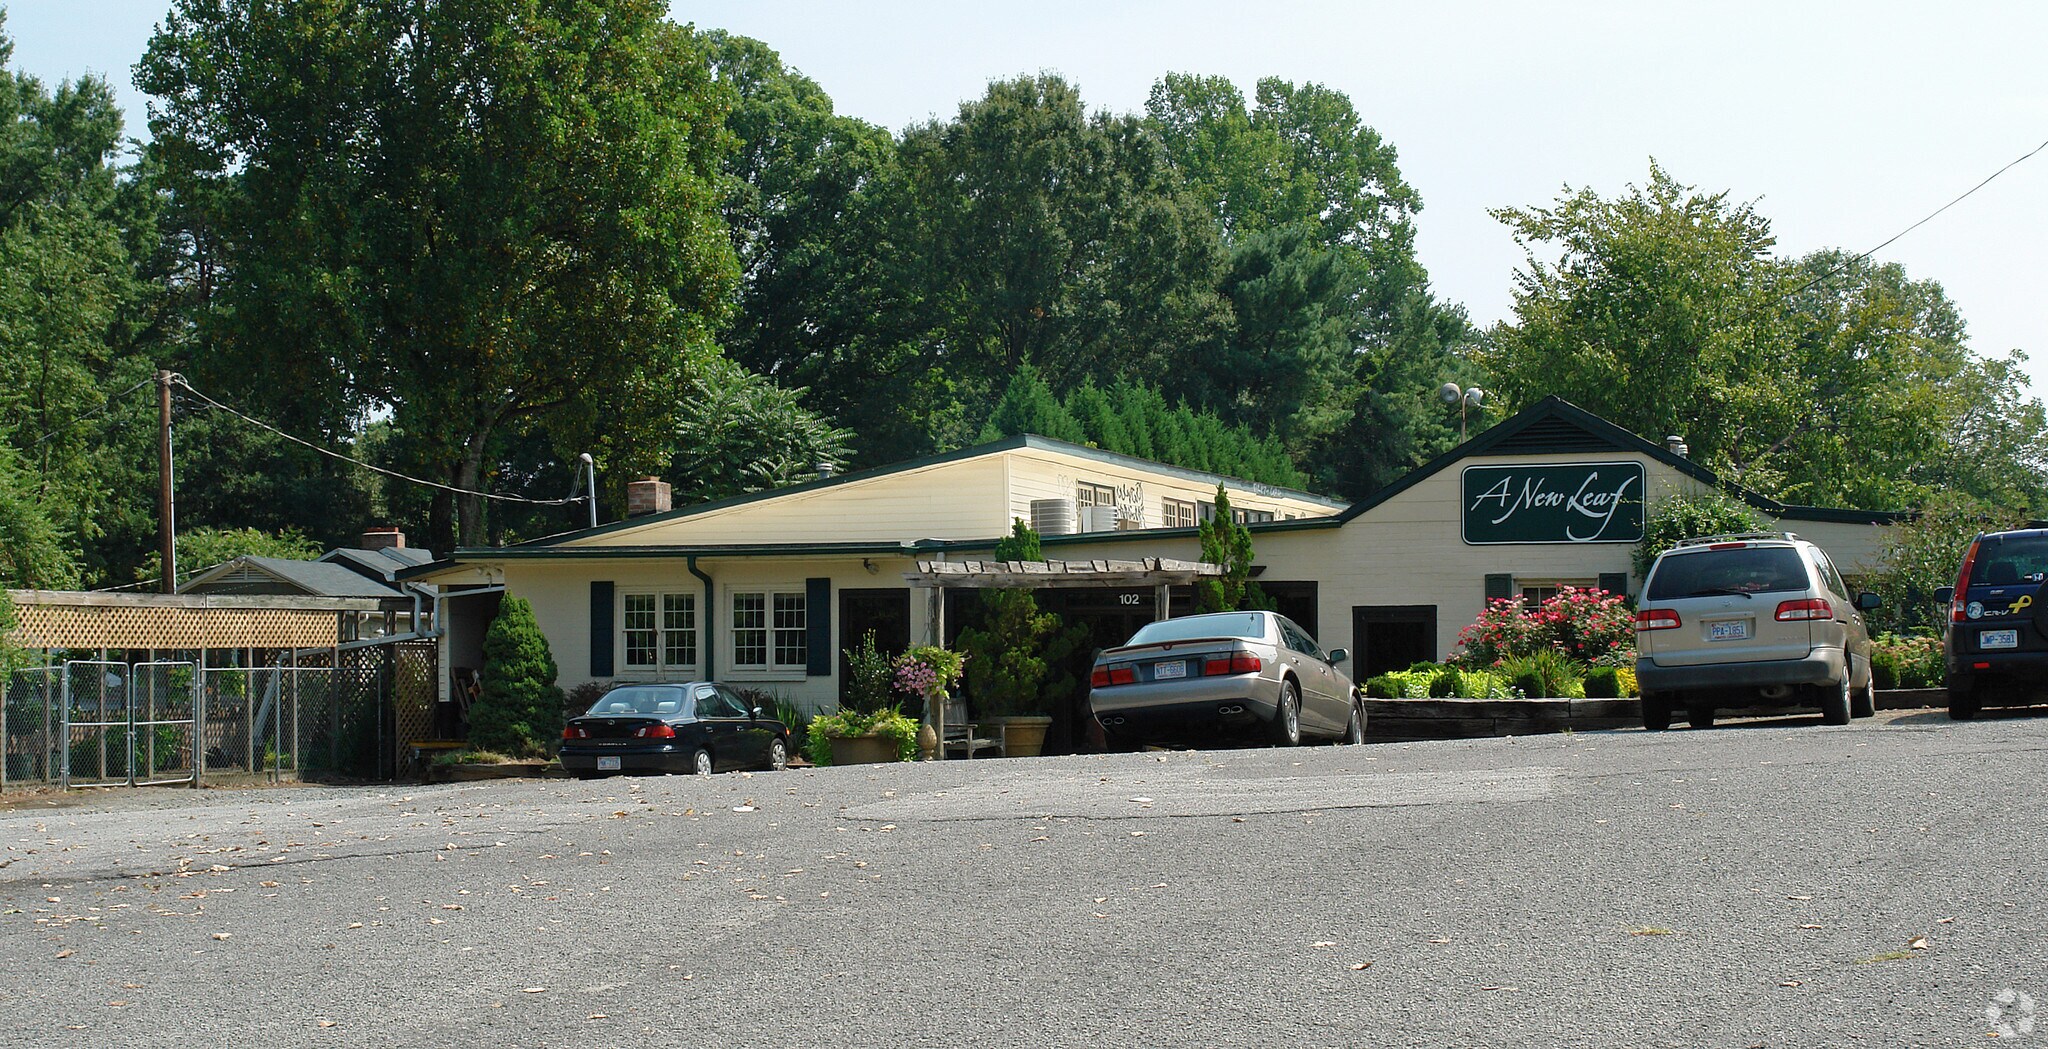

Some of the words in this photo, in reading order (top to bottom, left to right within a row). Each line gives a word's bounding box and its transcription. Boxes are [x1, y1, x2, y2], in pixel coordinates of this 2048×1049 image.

[1471, 475, 1512, 511] A
[1491, 477, 1565, 525] New
[1566, 471, 1638, 541] Leaf
[1119, 594, 1140, 605] 102
